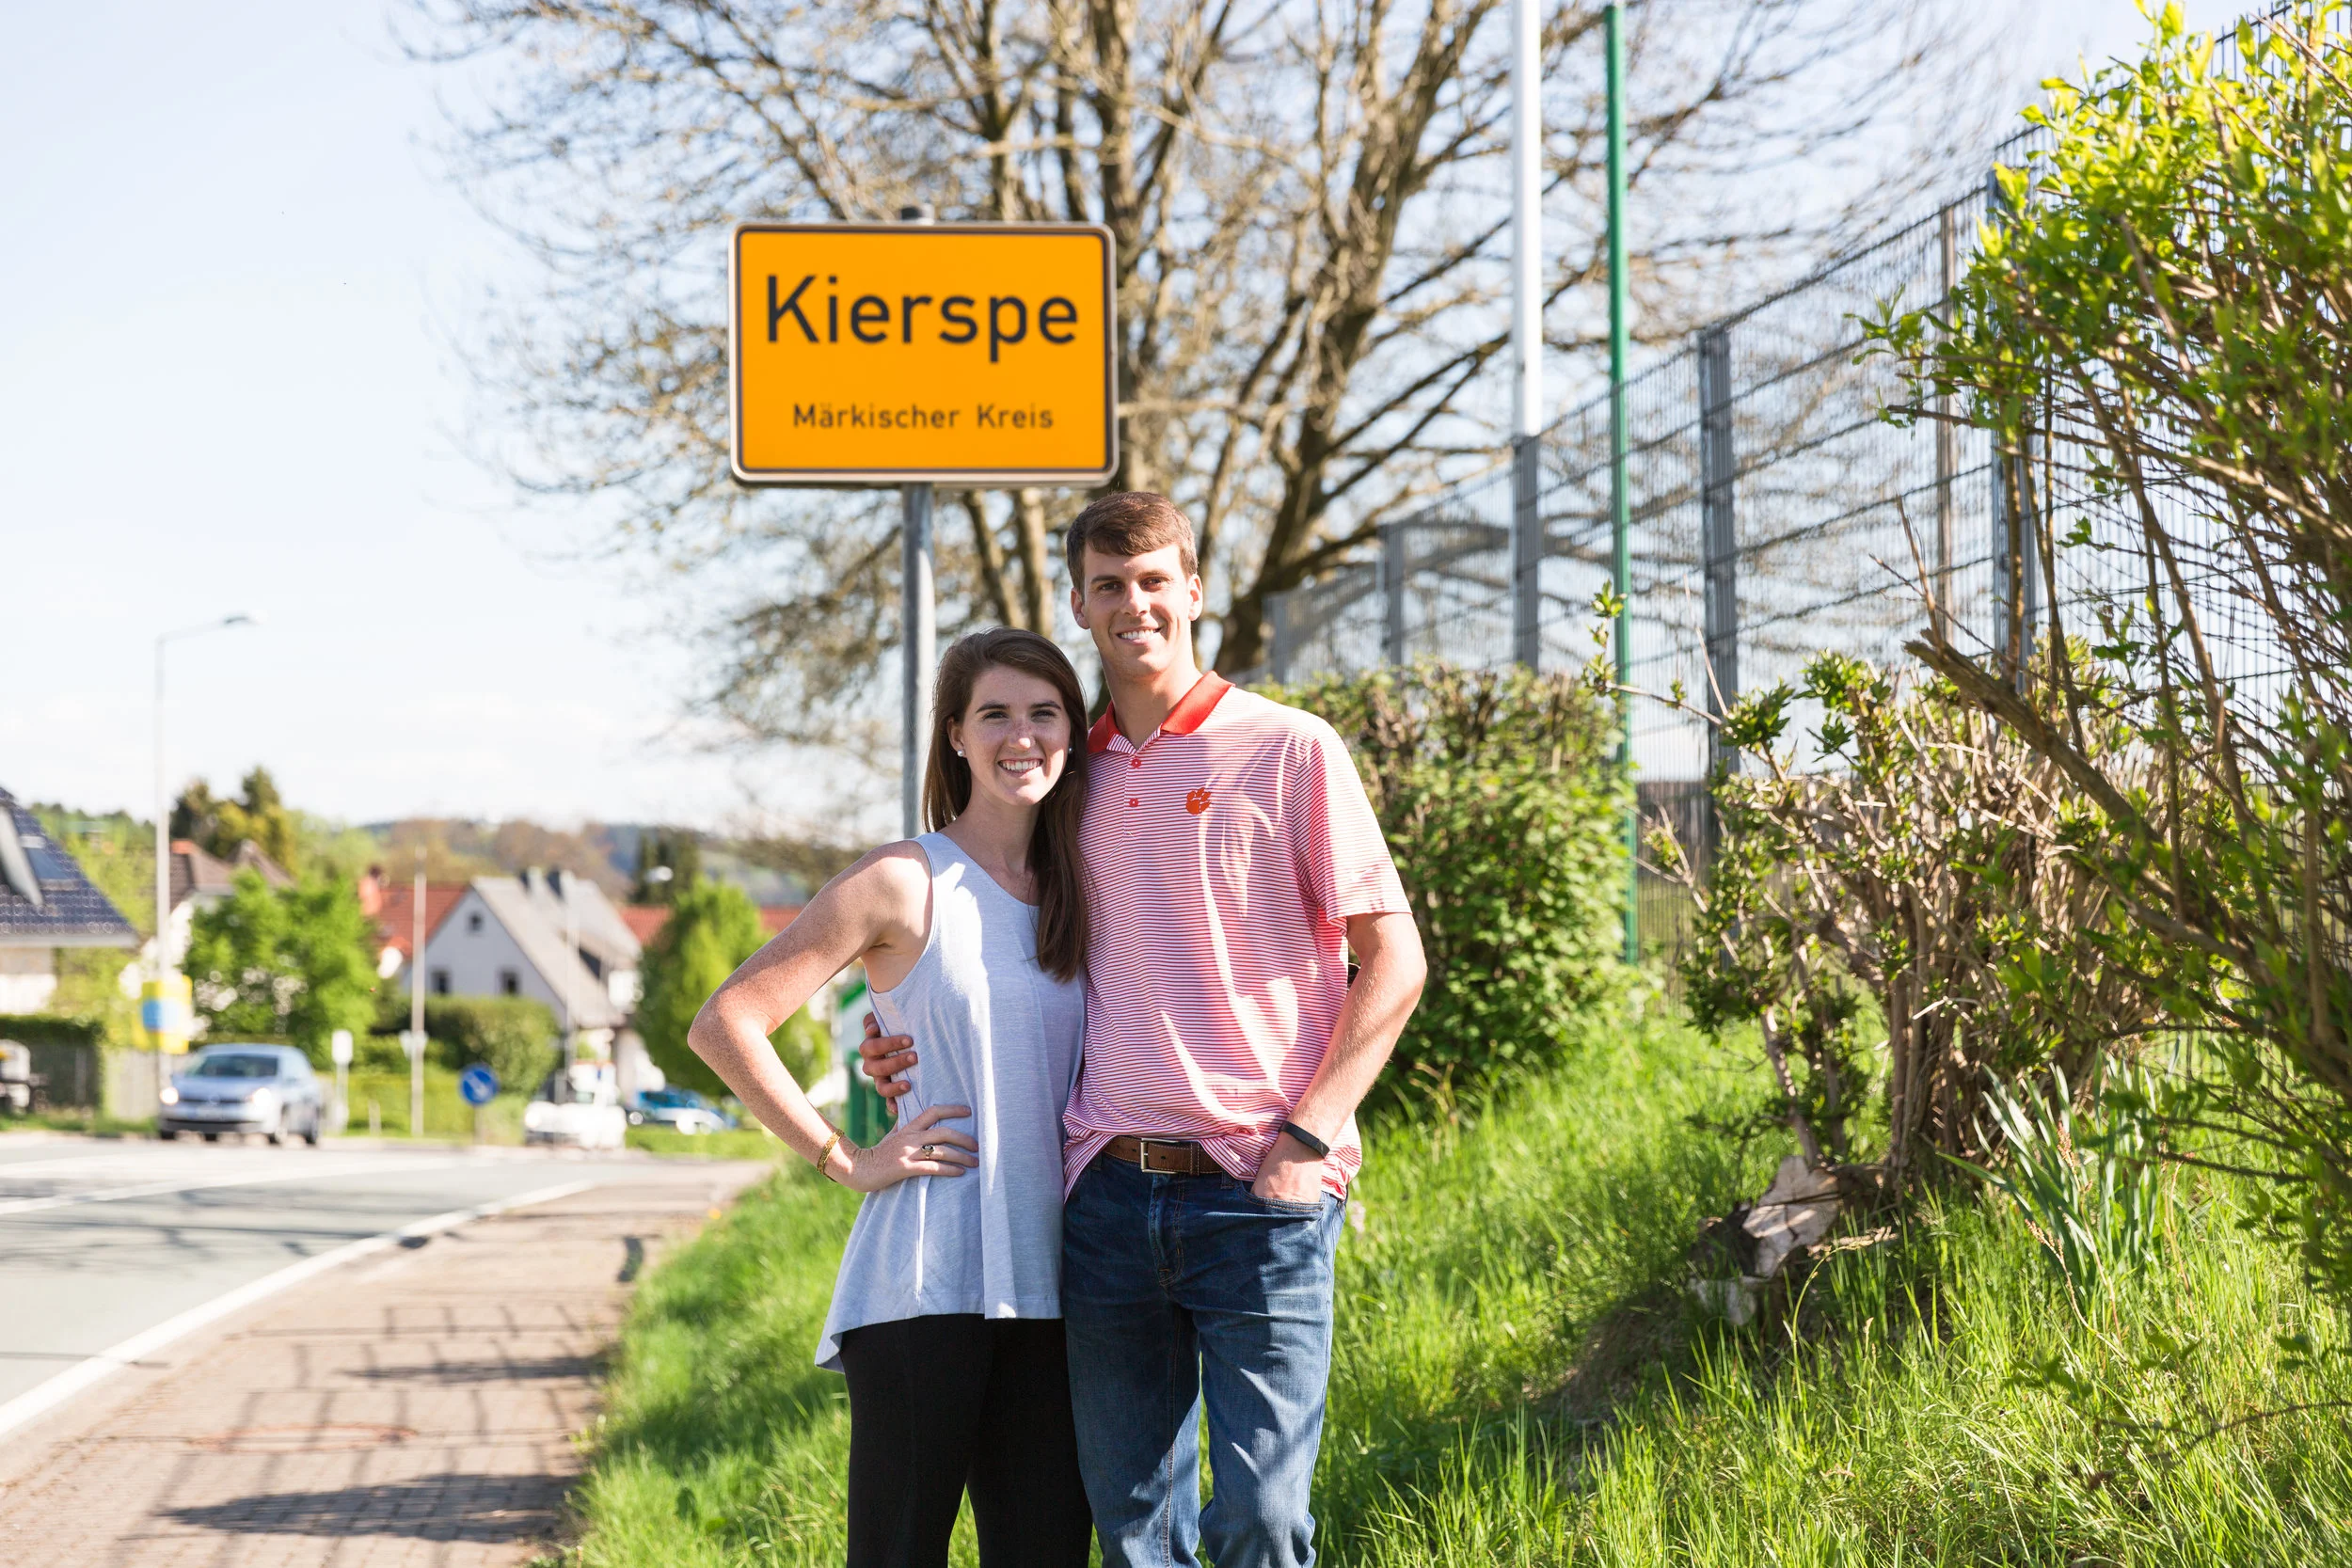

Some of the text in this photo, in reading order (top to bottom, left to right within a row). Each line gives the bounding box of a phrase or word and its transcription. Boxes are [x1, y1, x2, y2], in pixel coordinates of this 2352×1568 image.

[767, 275, 1078, 364] Kierspe
[793, 404, 1054, 429] Märkischer Kreis
